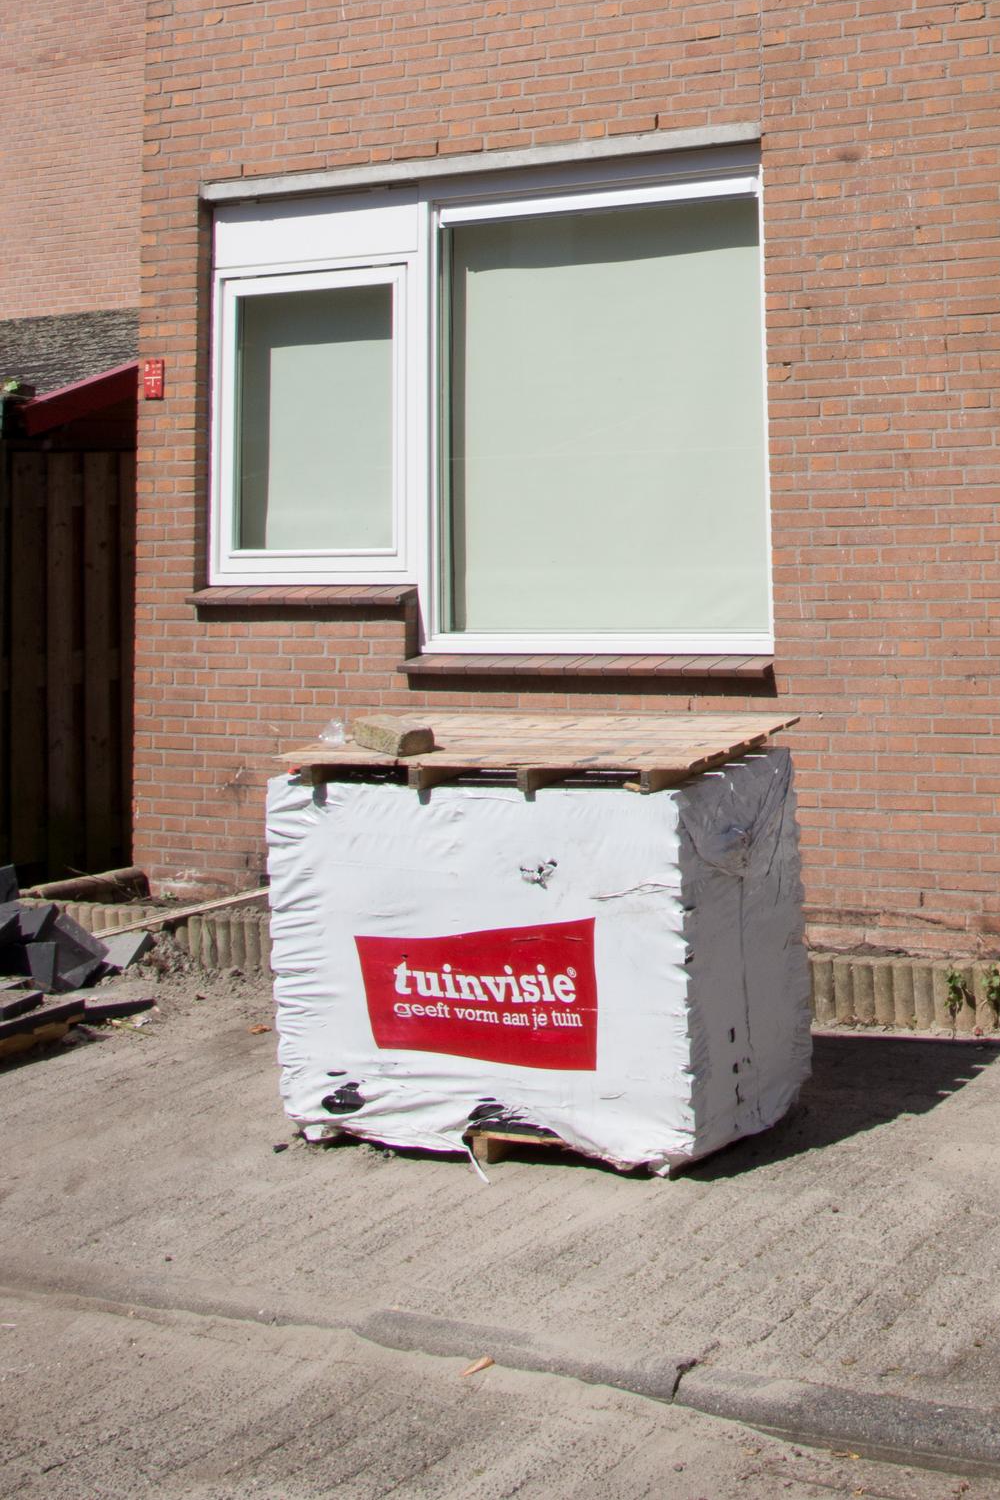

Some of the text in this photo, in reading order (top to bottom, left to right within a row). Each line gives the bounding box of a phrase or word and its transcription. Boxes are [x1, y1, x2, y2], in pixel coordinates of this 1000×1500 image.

[393, 1002, 583, 1030] geeft vorm aan je tuin
